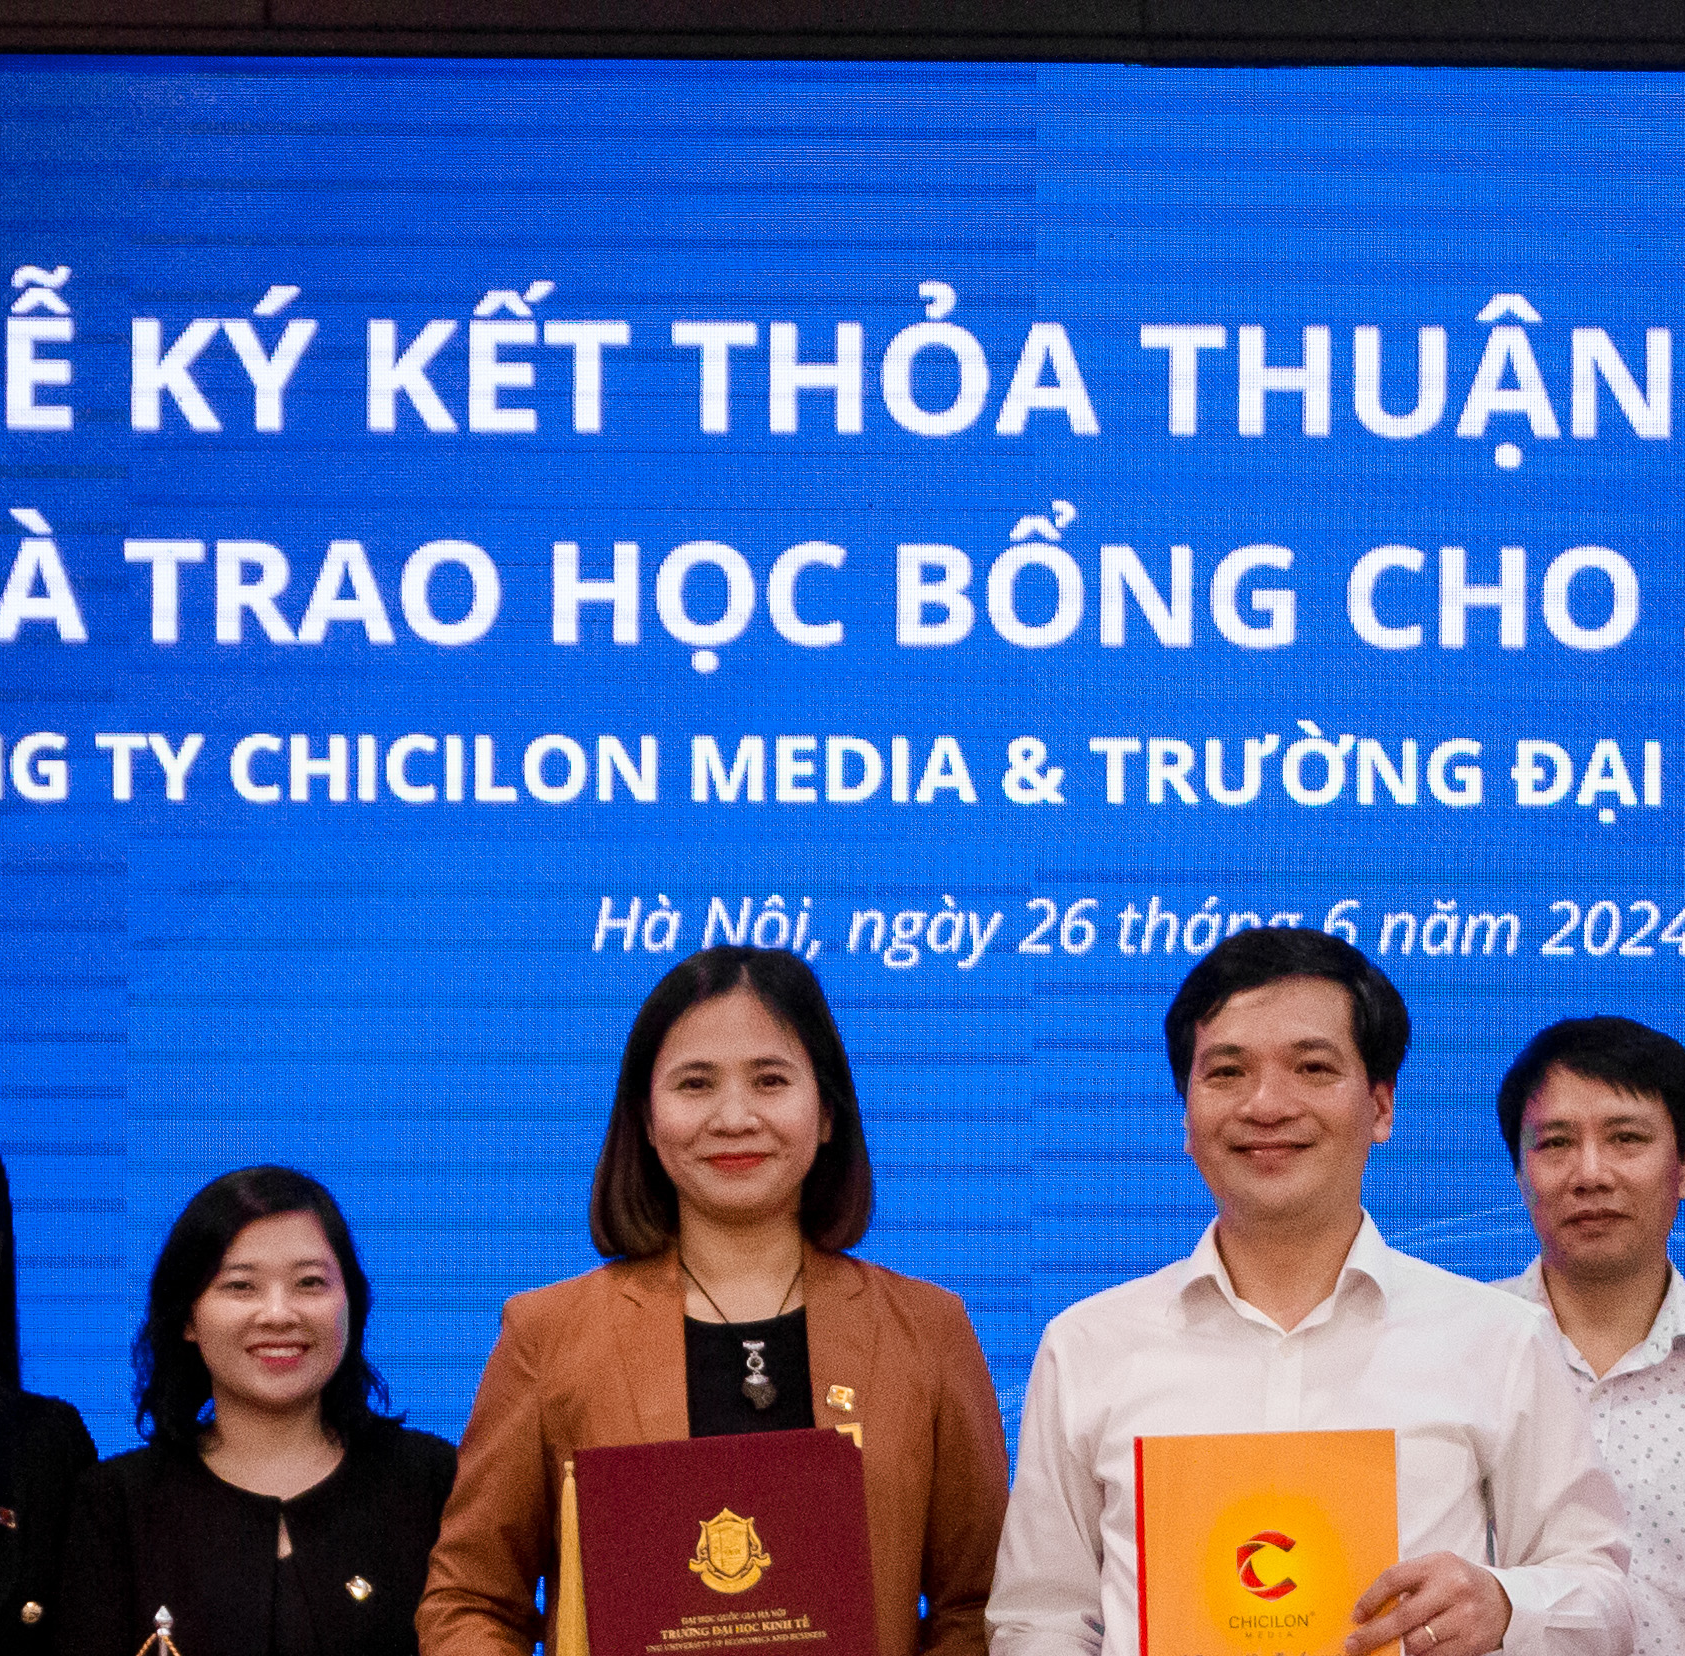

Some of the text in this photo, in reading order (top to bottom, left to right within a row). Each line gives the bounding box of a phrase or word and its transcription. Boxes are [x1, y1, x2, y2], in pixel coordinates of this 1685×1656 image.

[129, 284, 318, 433] KÝ
[365, 279, 631, 434] KẾT
[670, 280, 1102, 437] THỎA
[1139, 292, 1673, 470] THUẬN
[122, 538, 502, 647] TRAO
[551, 539, 848, 675] HỌC
[894, 499, 1297, 651] BỔNG
[1345, 542, 1640, 652] CHO
[93, 731, 206, 802] TY
[228, 732, 659, 804] CHICILON
[689, 733, 979, 805] MEDIA
[1000, 735, 1066, 806] &
[1087, 718, 1485, 810] TRƯỜNG
[1509, 737, 1663, 825] ĐẠI
[593, 893, 682, 953] Hà
[845, 893, 1005, 971] ngày
[1017, 897, 1100, 956] 26
[1379, 897, 1522, 957] năm
[762, 1619, 792, 1631] KINH
[1228, 1614, 1309, 1629] CHICILON
[1245, 1630, 1293, 1639] MEDIA
